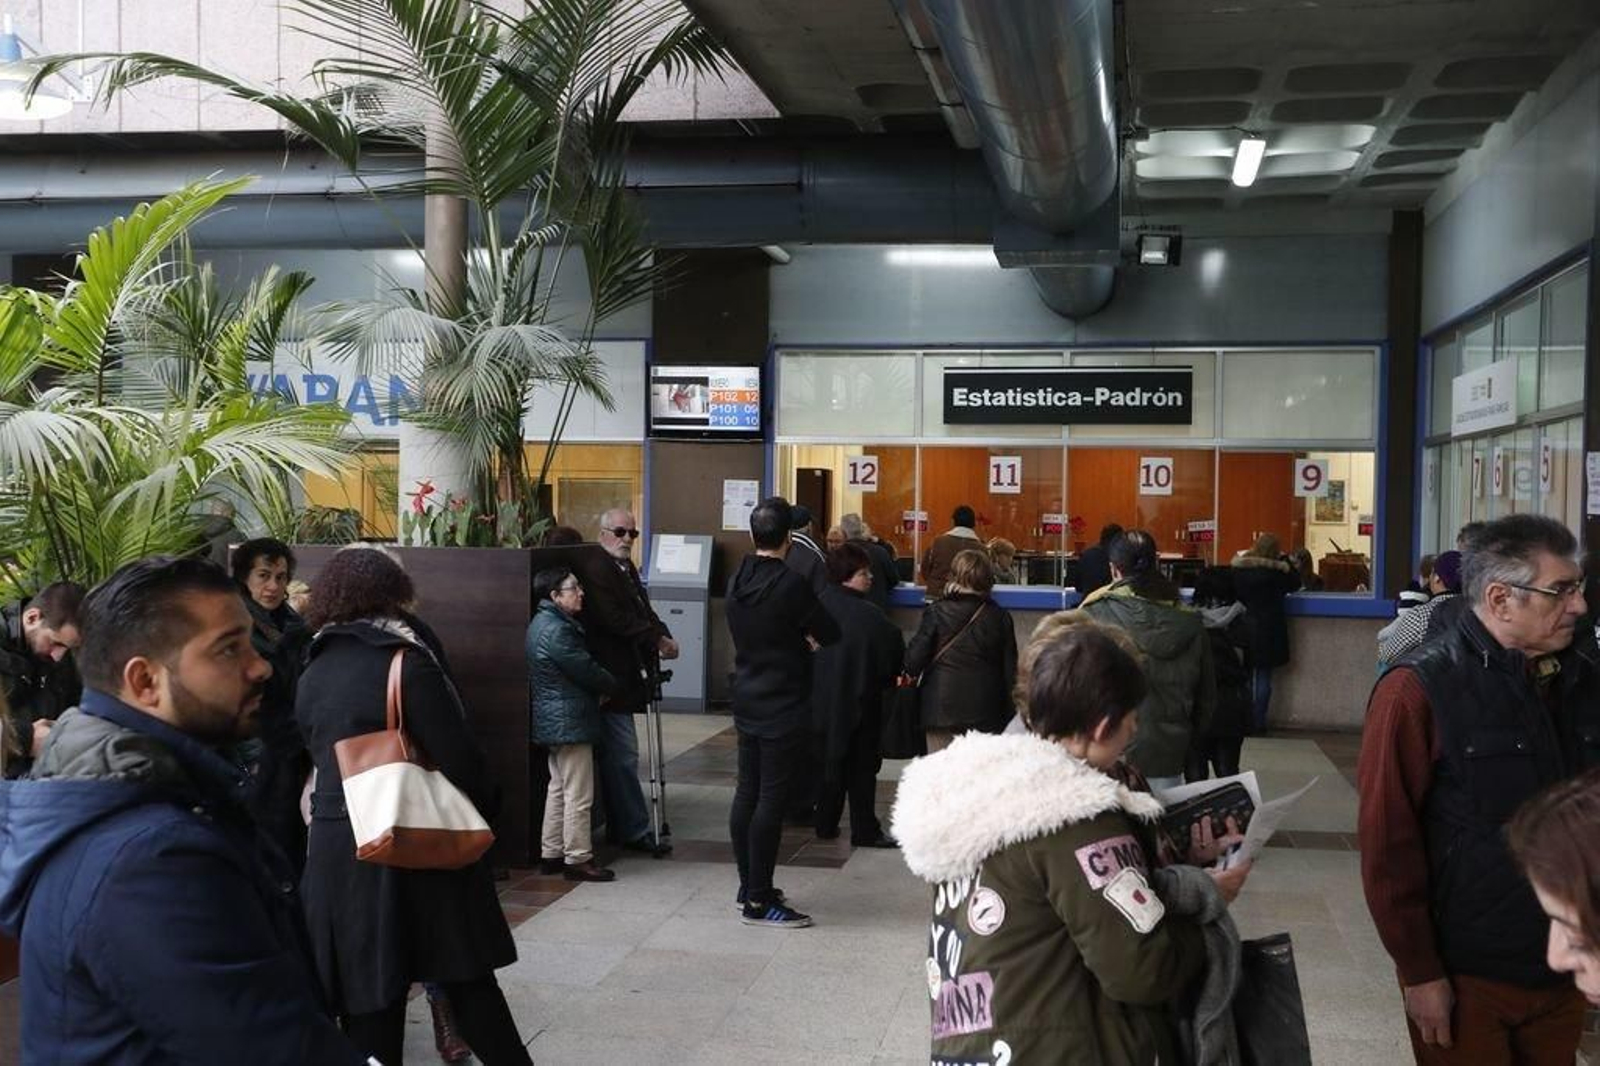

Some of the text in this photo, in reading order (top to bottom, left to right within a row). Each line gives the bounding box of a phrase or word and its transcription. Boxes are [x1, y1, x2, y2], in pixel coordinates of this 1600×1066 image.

[849, 461, 876, 485] 12
[992, 463, 1019, 487] 11
[1141, 464, 1171, 488] 10
[1474, 457, 1481, 490] 7
[1494, 453, 1501, 487] 6
[1541, 445, 1550, 482] 5
[1302, 464, 1323, 492] 9
